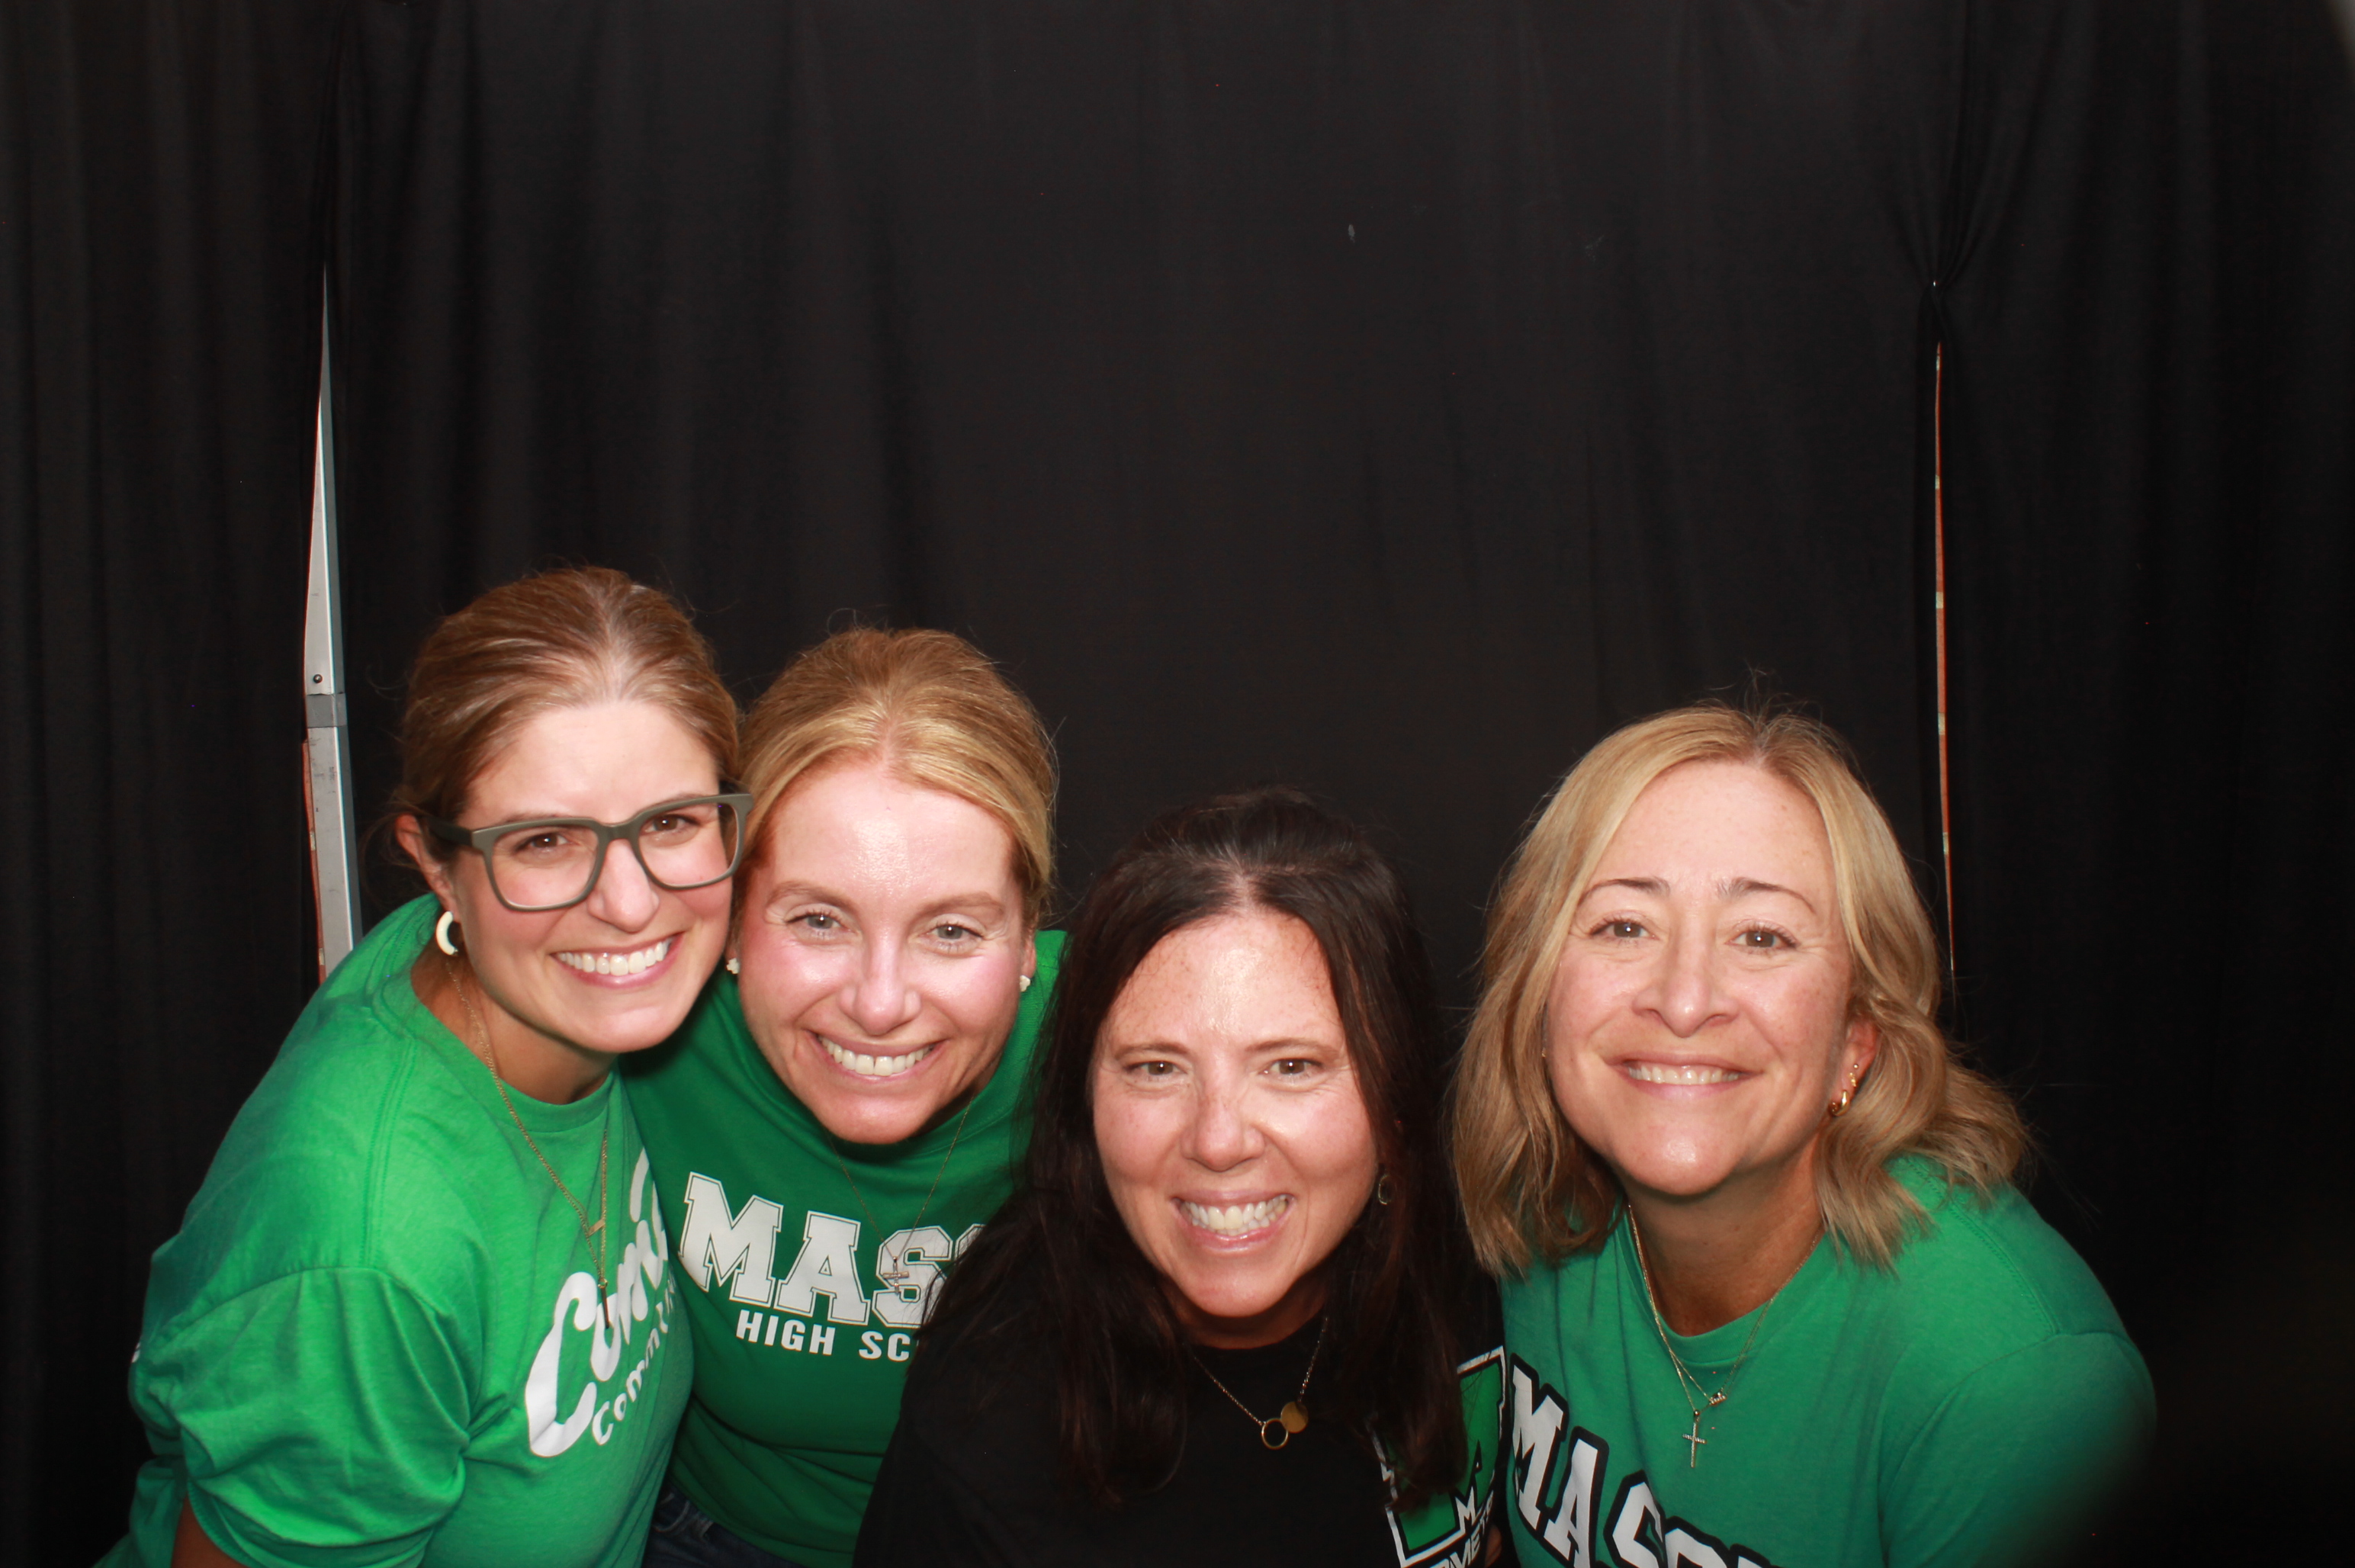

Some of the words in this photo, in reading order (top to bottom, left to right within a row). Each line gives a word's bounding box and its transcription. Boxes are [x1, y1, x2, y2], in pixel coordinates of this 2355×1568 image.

[678, 1171, 986, 1329] MAS
[736, 1309, 837, 1356] HIGH
[859, 1330, 920, 1362] SC
[1508, 1356, 1774, 1568] MAS
